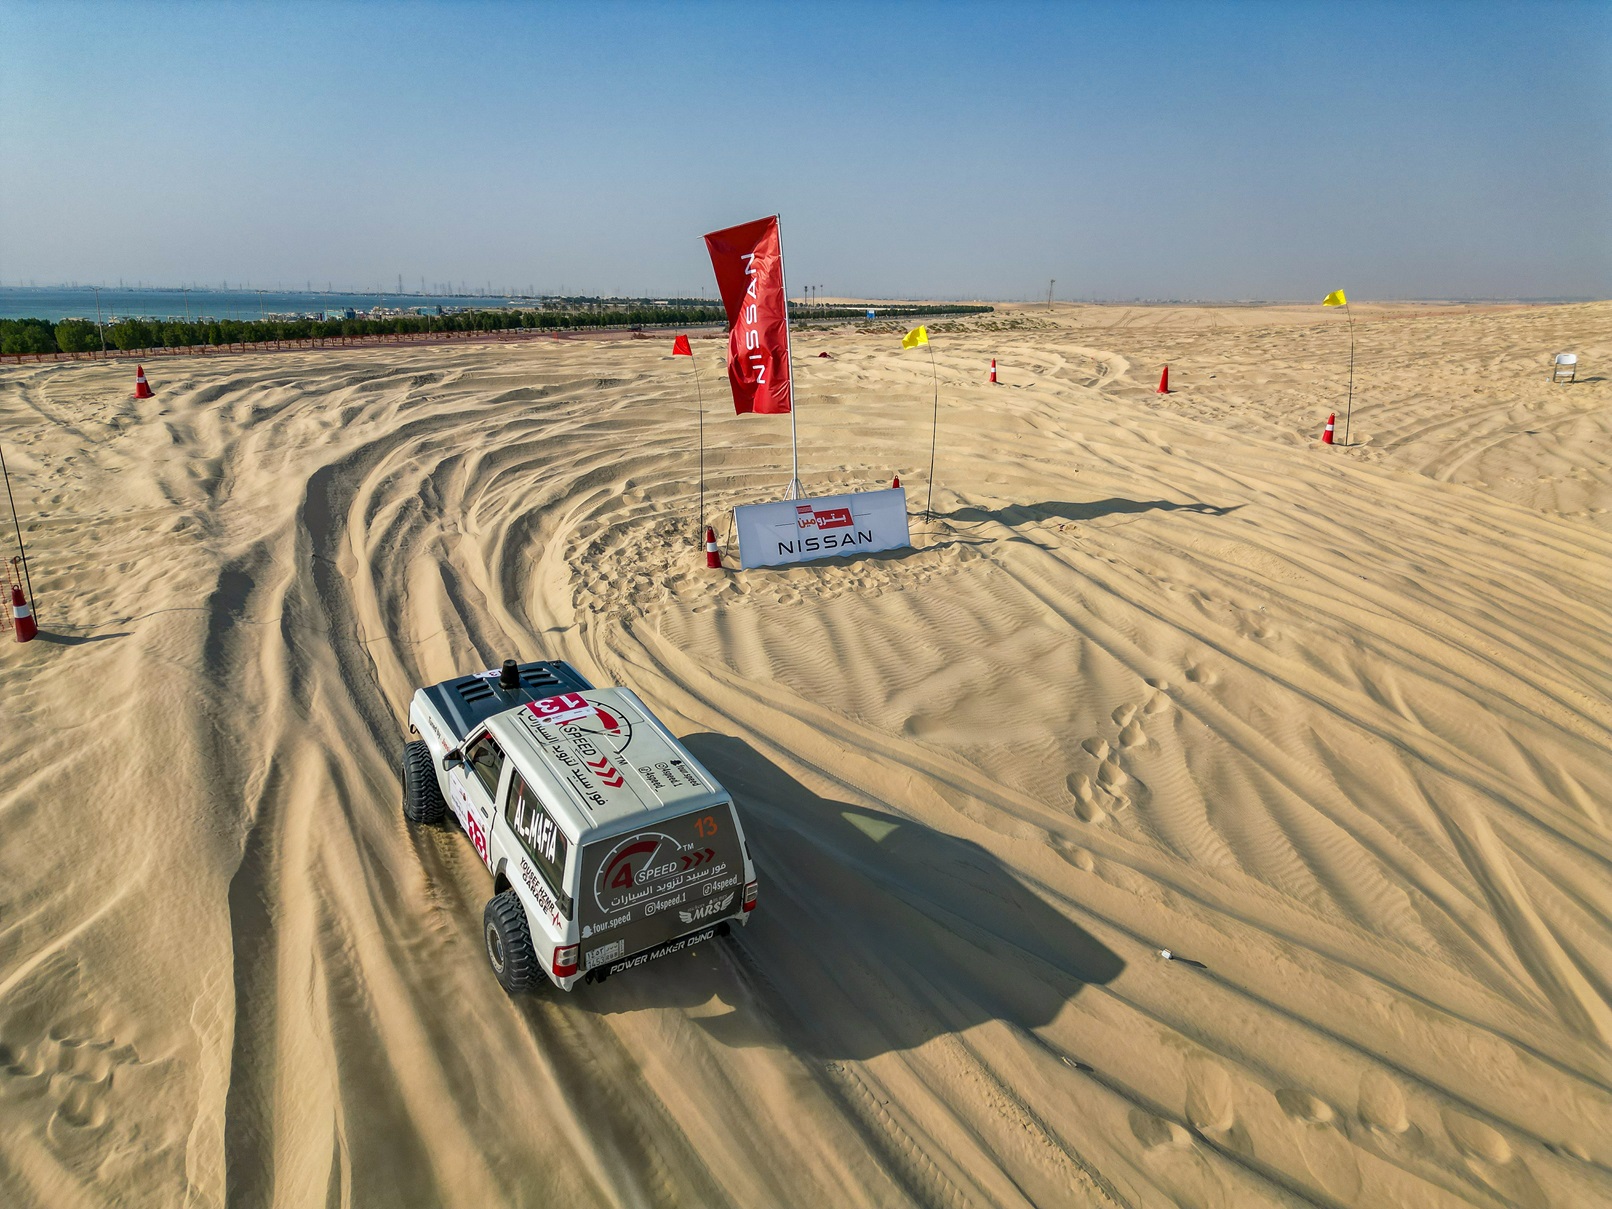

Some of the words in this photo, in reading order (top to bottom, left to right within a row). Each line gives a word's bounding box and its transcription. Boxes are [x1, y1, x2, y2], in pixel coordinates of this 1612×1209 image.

[741, 252, 766, 384] NISSAN
[797, 513, 847, 529] بترومين
[778, 530, 873, 555] NISSAN
[534, 695, 580, 713] 13
[563, 726, 597, 756] SPEED
[552, 744, 580, 772] لتزويد
[614, 755, 629, 767] TM
[571, 768, 594, 790] سبيد
[586, 790, 609, 806] فور
[694, 815, 719, 838] 13
[682, 843, 695, 852] TM
[520, 857, 540, 886] YOUSEF
[611, 862, 634, 889] 4
[638, 861, 678, 882] SPEED
[686, 869, 710, 884] سبيد
[711, 861, 727, 876] فور
[522, 873, 547, 915] GARAGE
[656, 874, 684, 893] لتزويد
[610, 884, 653, 907] السيارات
[656, 892, 687, 912] 4speed.1
[592, 912, 631, 934] four.speed
[610, 953, 648, 975] POWER
[650, 939, 686, 960] MAKER
[687, 930, 714, 947] DYNO
